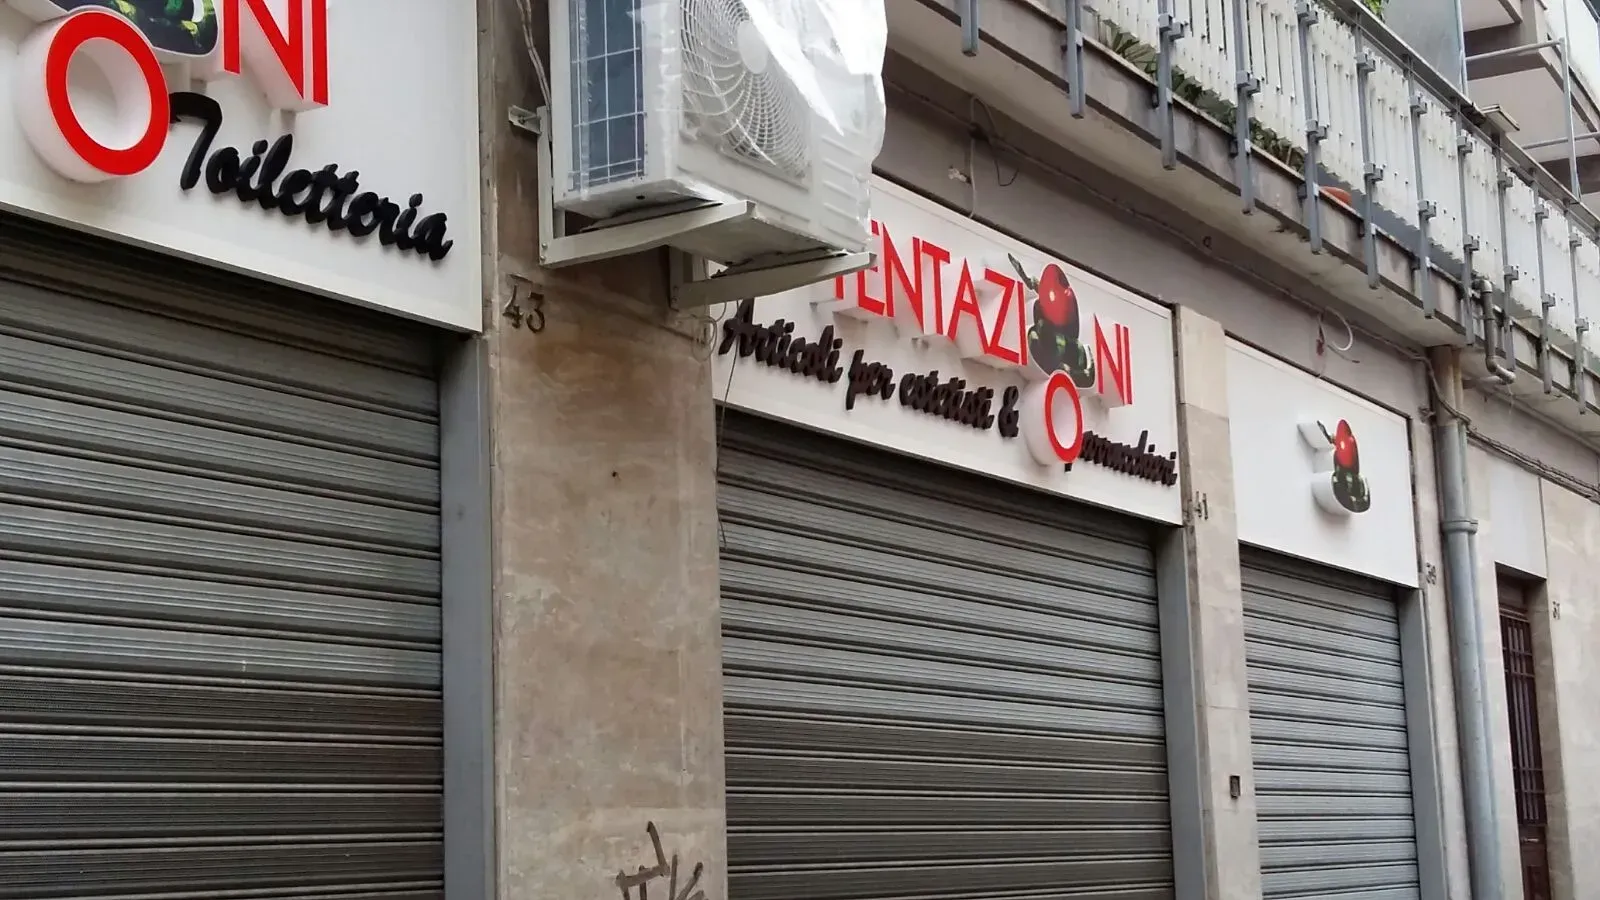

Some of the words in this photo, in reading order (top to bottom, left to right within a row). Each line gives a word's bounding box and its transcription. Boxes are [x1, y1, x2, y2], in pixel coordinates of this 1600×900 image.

[502, 274, 546, 334] 43
[718, 297, 844, 384] Articoli
[846, 349, 896, 411] per
[998, 385, 1020, 438] &
[1064, 430, 1178, 487] arrucchieri
